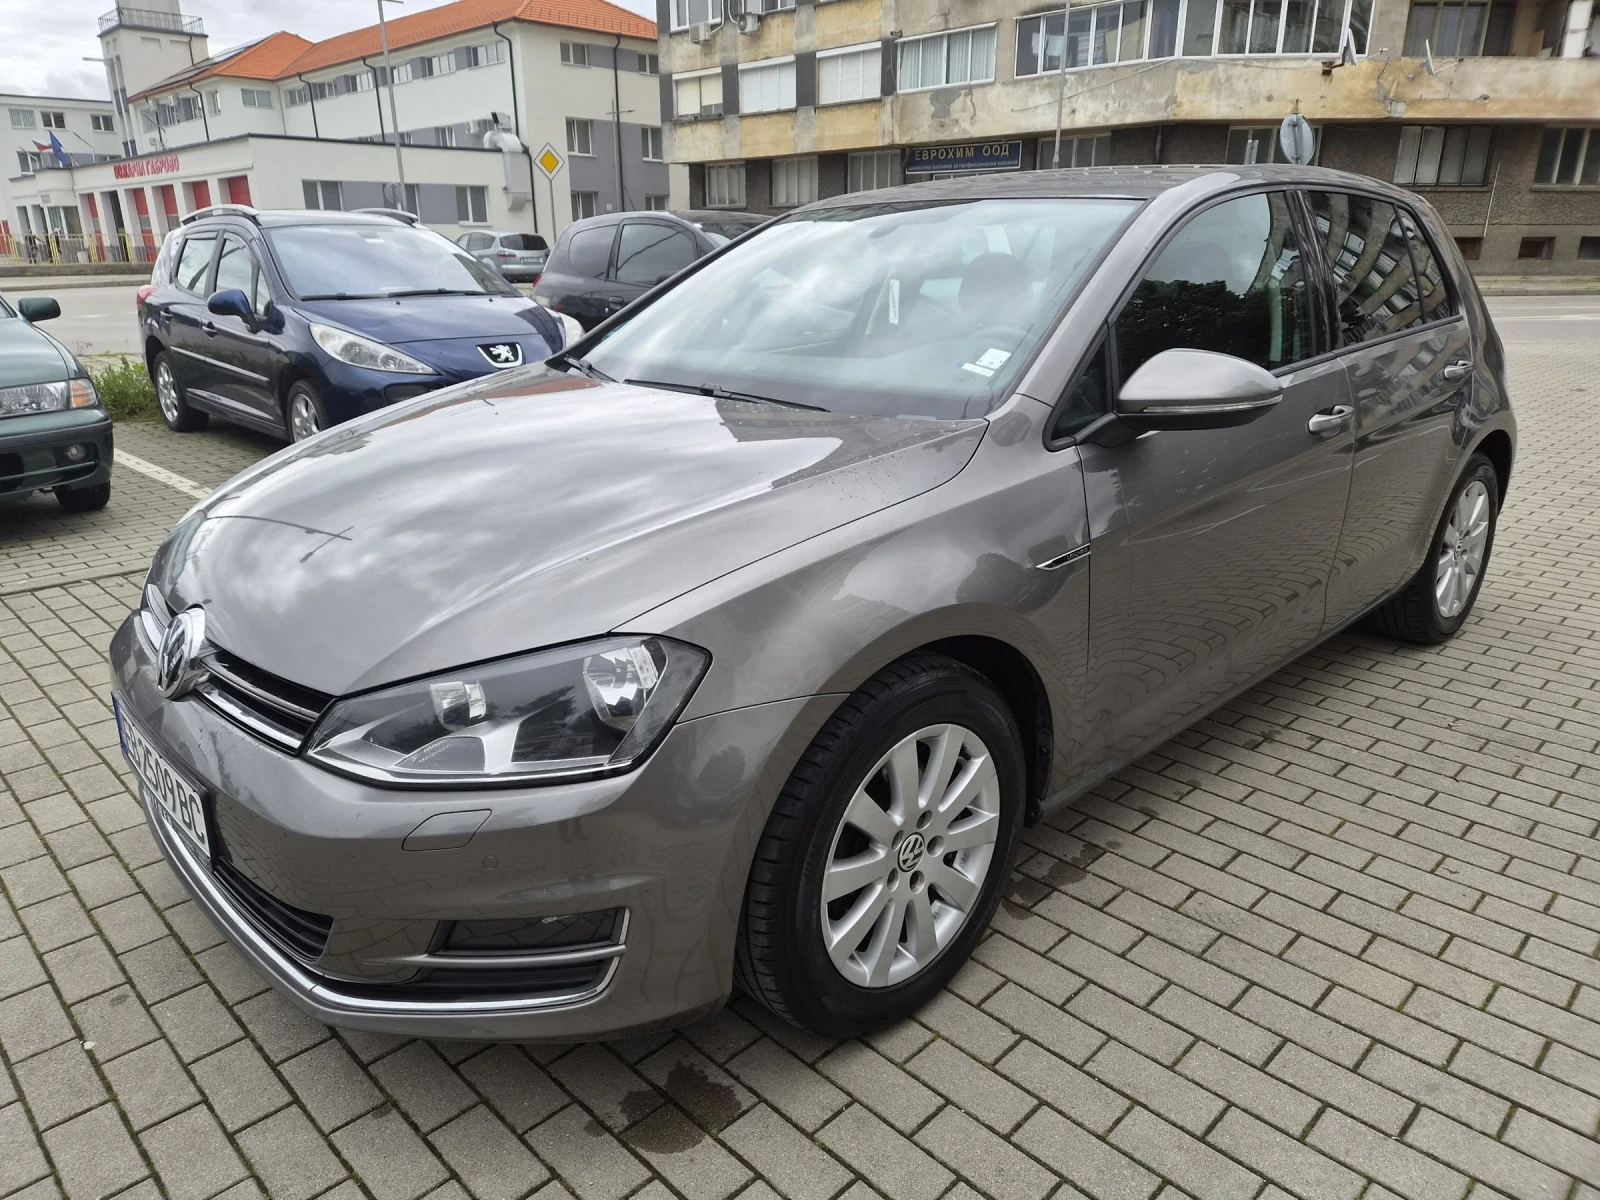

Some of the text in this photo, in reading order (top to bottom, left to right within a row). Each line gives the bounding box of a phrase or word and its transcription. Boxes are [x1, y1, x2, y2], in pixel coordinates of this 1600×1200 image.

[914, 144, 1010, 160] ЕВРОХИМ ООД
[146, 155, 179, 175] ГАБРОВО
[138, 737, 176, 814] 2509
[175, 777, 205, 845] BC
